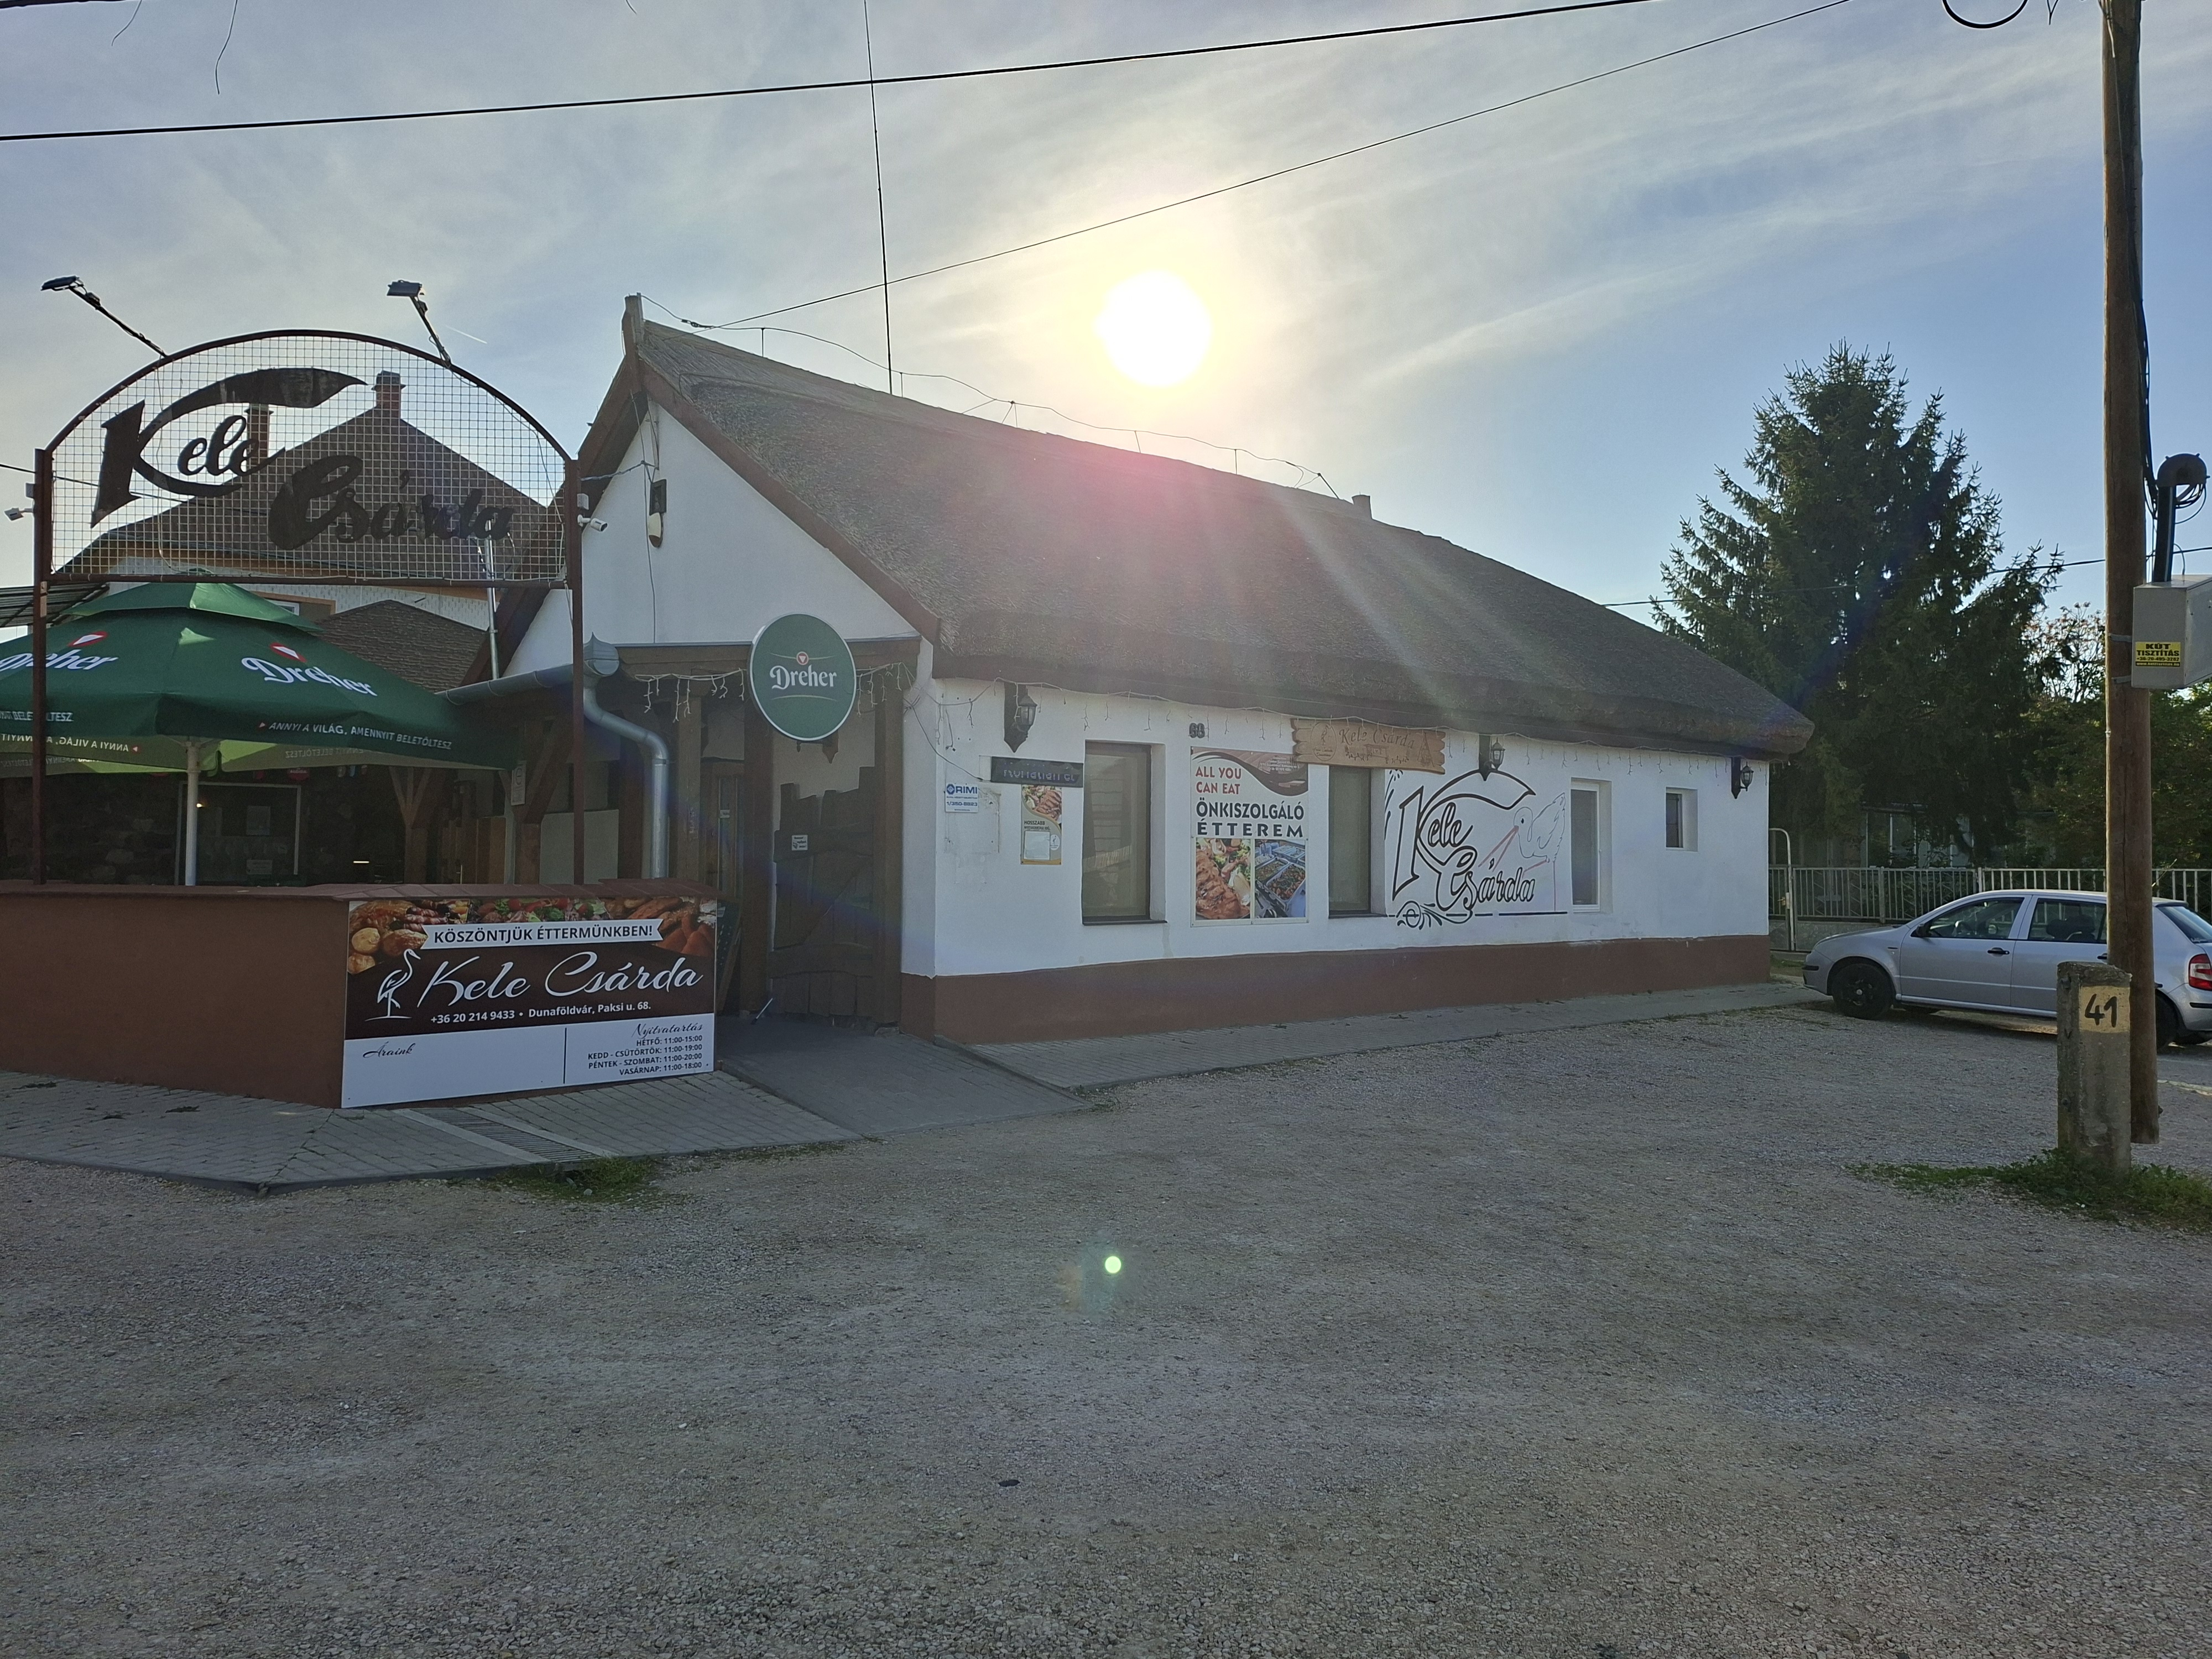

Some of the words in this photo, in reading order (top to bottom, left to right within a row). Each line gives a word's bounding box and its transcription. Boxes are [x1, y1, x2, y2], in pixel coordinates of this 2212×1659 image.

[90, 367, 368, 528] Kele
[268, 455, 515, 550] Csárda
[241, 657, 377, 696] Dreher
[770, 665, 837, 690] Dreher
[12, 711, 74, 721] BELELTESZ
[269, 722, 302, 732] ANNYI
[302, 724, 310, 732] A
[351, 726, 395, 741] AMENNYIT
[396, 733, 452, 750] BELETÖLTESZ
[1190, 723, 1205, 738] 68
[1196, 766, 1215, 778] ALL
[1219, 767, 1241, 779] YOU
[956, 786, 977, 794] RIMI
[1196, 781, 1218, 793] CAN
[1222, 783, 1240, 795] EAT
[1196, 797, 1305, 820] ÖNKISZOLGÁLÓ
[1197, 818, 1303, 838] ÉTTEREM
[1392, 768, 1536, 900] Kele
[1437, 846, 1535, 911] Csárda
[434, 927, 533, 944] KÖSZÖNTJÜK
[537, 925, 653, 940] ÉTTERMÜNKBEN!
[417, 956, 530, 1008] Kele
[545, 951, 703, 996] Csárda
[431, 1014, 450, 1024] +36
[453, 1014, 466, 1022] 20
[468, 1012, 487, 1021] 214
[490, 1010, 515, 1020] 9433
[529, 1005, 595, 1018] Dunaföldvár,
[598, 1003, 624, 1013] Paksi
[637, 1001, 651, 1010] 68.
[2084, 993, 2117, 1027] 41
[631, 1022, 703, 1039] Nyitvatartás
[363, 1041, 416, 1058] Áraink
[637, 1038, 662, 1046] HÉTFŐ:
[664, 1035, 703, 1044] 11:00-15:00
[615, 1047, 662, 1057] CSÜTÖRTÖK:
[664, 1044, 702, 1053] 11:00-19:00
[588, 1060, 618, 1069] PÉNTEK
[624, 1056, 662, 1066] SZOMBAT:
[664, 1053, 702, 1062] 11:00-20:00
[619, 1066, 662, 1076] VASÁRNAP:
[664, 1062, 702, 1071] 11:00-18:00
